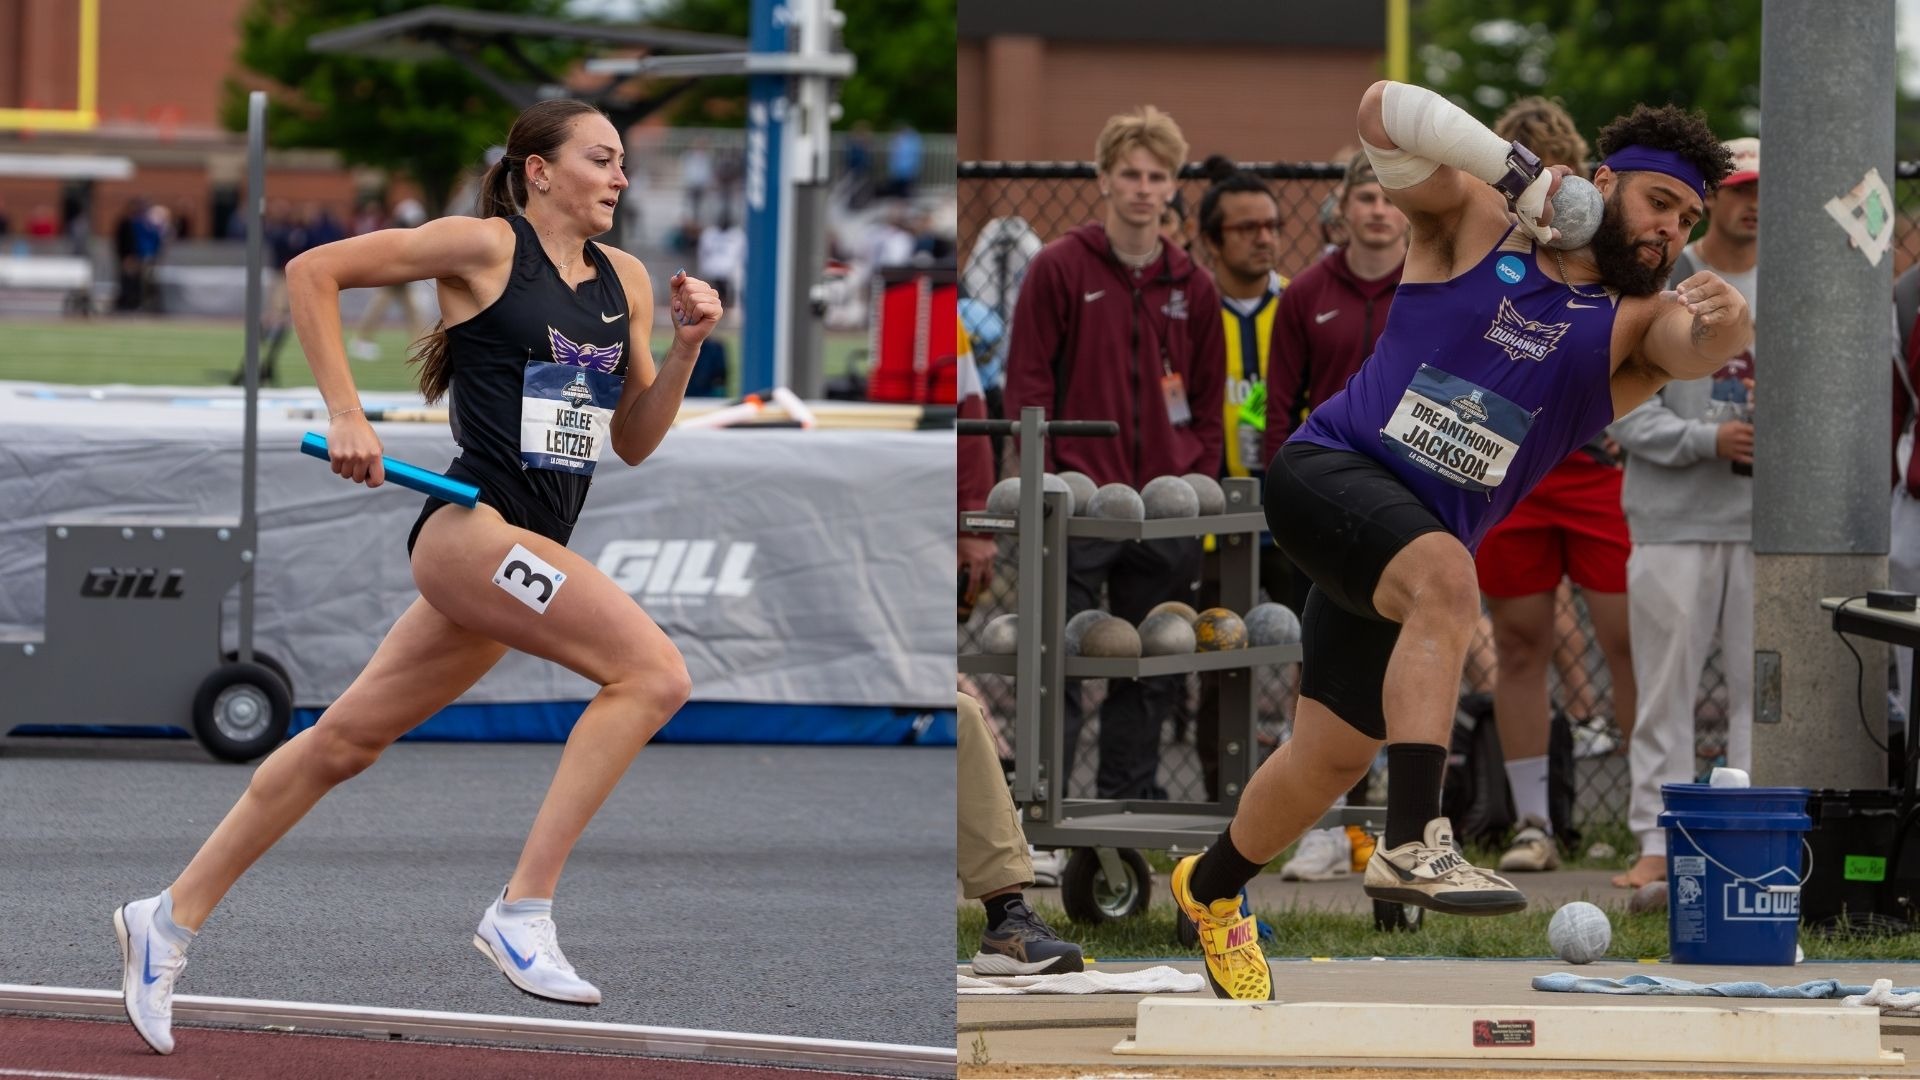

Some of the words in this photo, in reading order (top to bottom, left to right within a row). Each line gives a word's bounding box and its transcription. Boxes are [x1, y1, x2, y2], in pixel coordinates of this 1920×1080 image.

[1499, 263, 1521, 282] NCAA
[1490, 326, 1547, 358] DUHAWKS
[556, 409, 593, 430] KEELEE
[1411, 402, 1504, 460] DREANTHONY
[546, 430, 594, 458] LEITZEN
[1402, 425, 1490, 481] JACKSON
[1416, 454, 1437, 471] CROSSE,
[80, 567, 184, 598] GILL
[504, 560, 553, 604] 3
[596, 539, 756, 597] GILL
[1738, 888, 1800, 914] LOWE
[1227, 921, 1253, 949] NIKE
